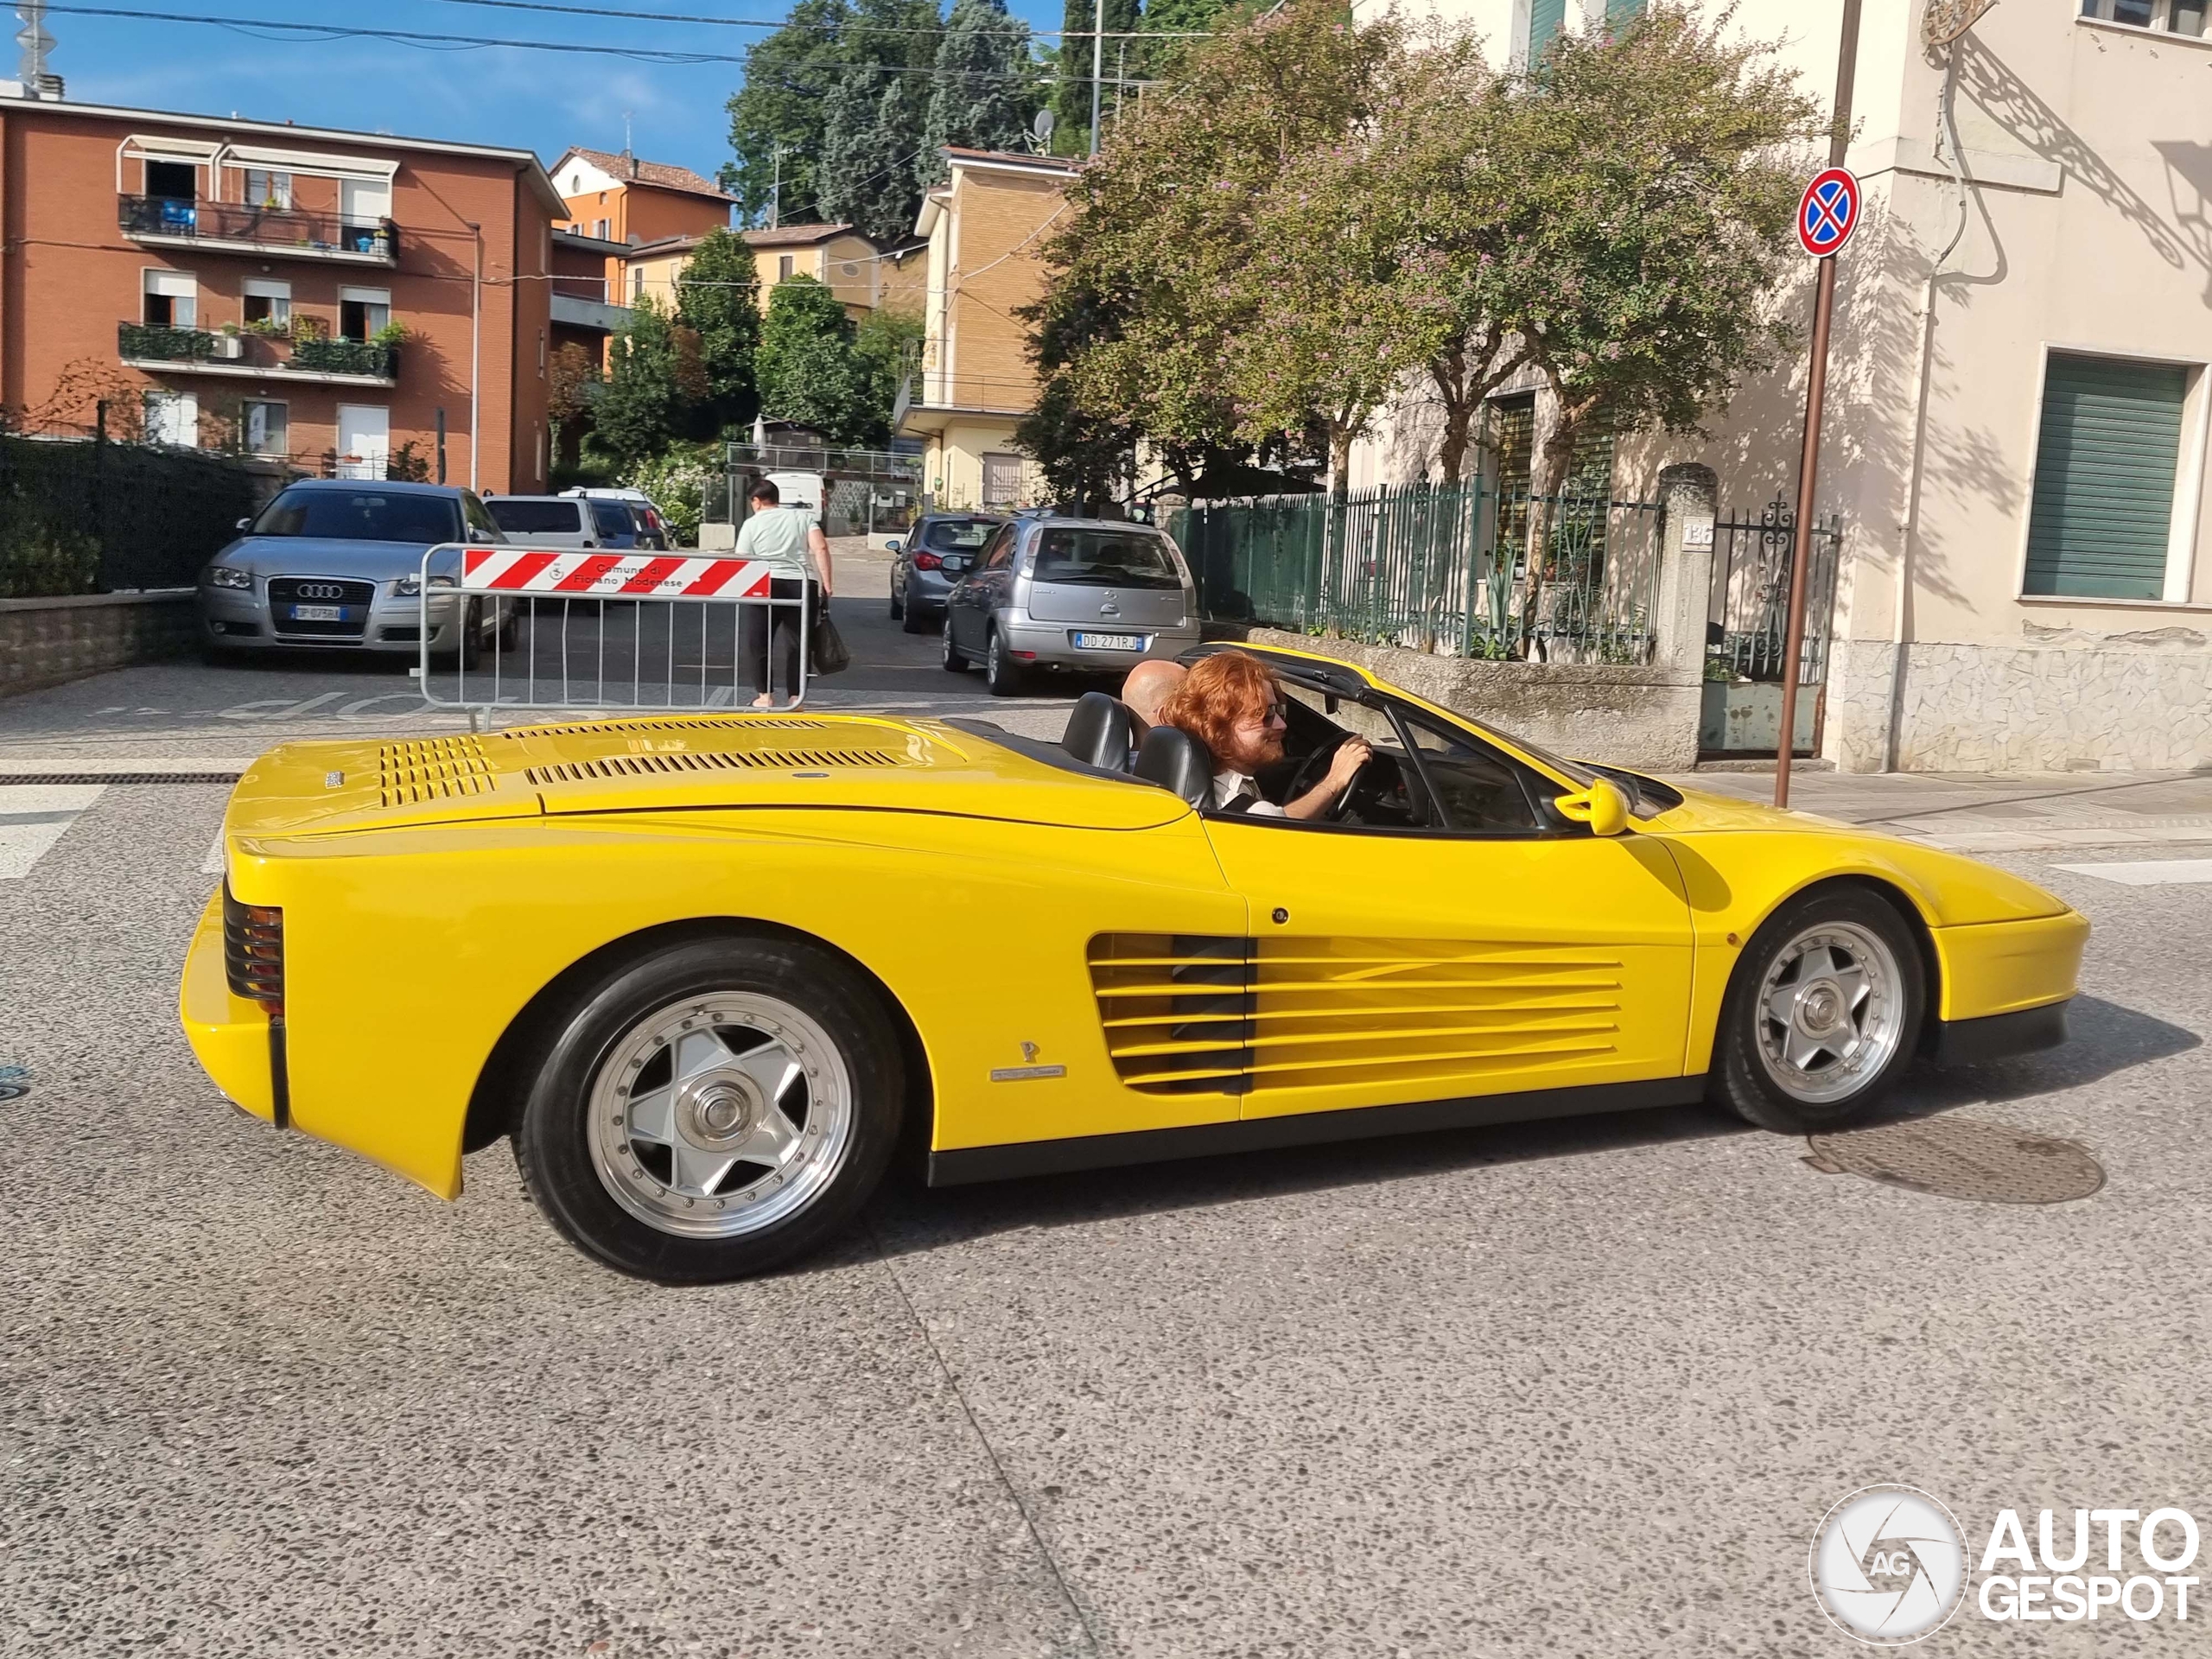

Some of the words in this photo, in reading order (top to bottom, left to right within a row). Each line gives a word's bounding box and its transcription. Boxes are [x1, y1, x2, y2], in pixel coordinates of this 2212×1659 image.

[1683, 524, 1713, 544] 136
[596, 563, 645, 575] Comune
[650, 566, 661, 575] di
[574, 575, 619, 585] Fiorano
[625, 577, 683, 588] Modenese
